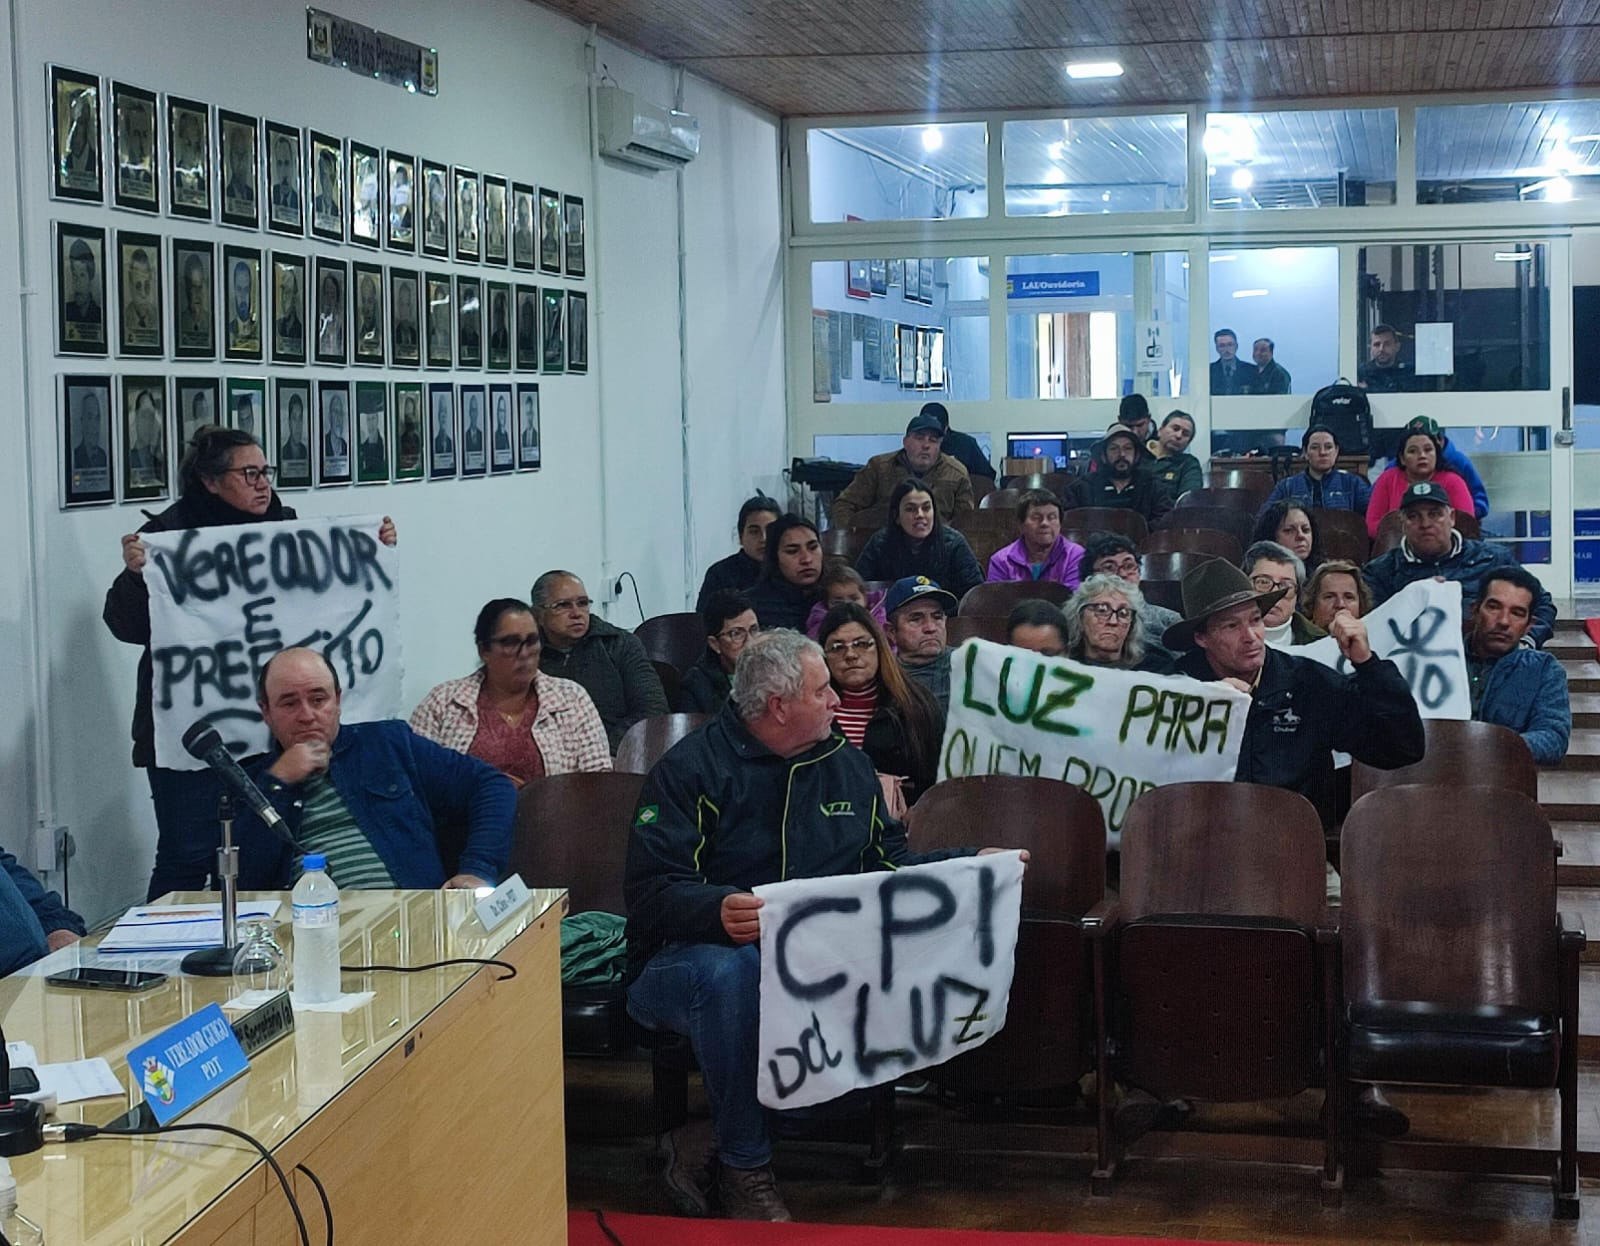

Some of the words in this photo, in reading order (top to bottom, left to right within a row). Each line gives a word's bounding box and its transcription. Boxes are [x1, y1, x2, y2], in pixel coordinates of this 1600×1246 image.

[242, 597, 281, 644] E
[963, 643, 1094, 736] LUZ
[1119, 685, 1232, 754] PARA
[776, 866, 995, 1001] CPI
[164, 1030, 209, 1069] VEREADOR
[853, 974, 989, 1078] LUZ
[201, 1055, 223, 1081] PDT
